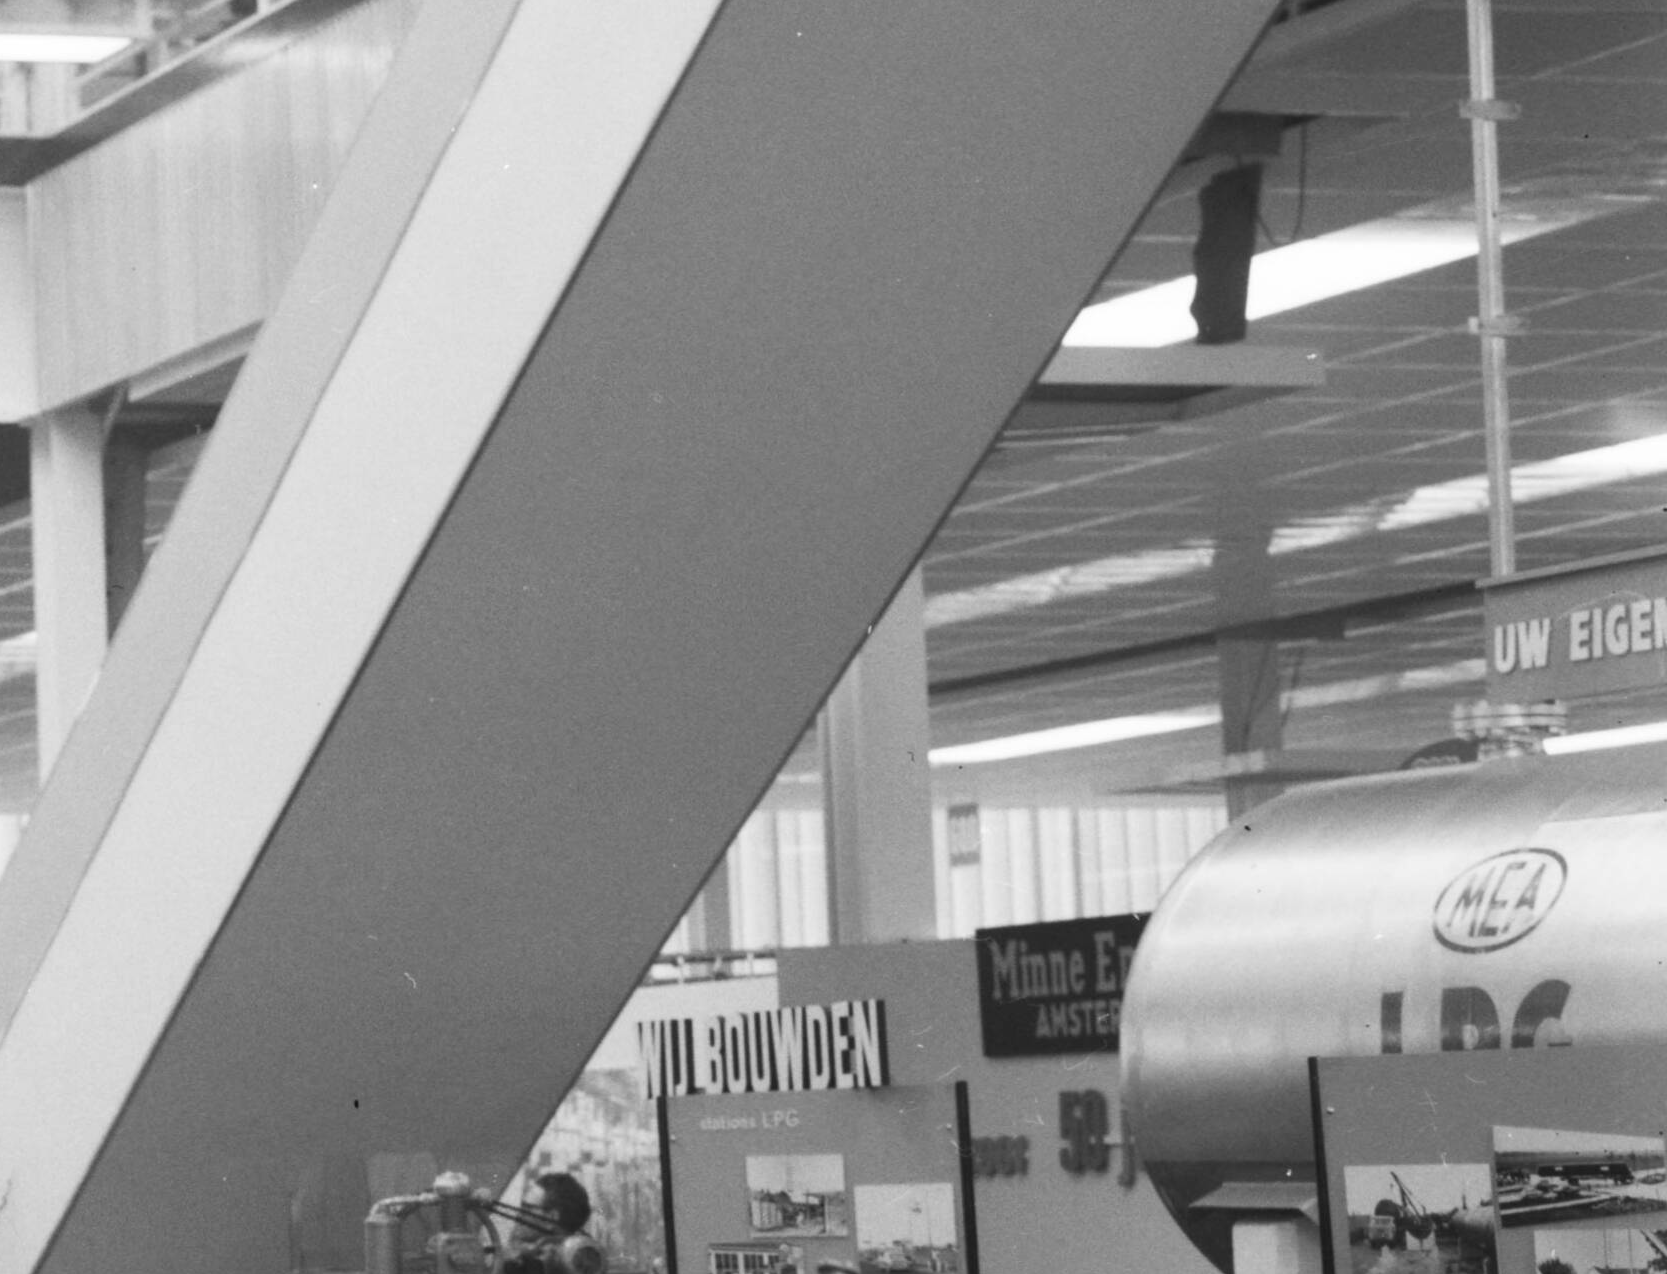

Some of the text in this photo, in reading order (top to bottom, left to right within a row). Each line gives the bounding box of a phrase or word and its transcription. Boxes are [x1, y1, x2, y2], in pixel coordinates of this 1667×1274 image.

[1494, 619, 1550, 673] UW
[1446, 861, 1548, 938] MEA
[989, 937, 1085, 999] Minne
[701, 997, 890, 1095] BOUWDEN
[762, 1108, 800, 1129] LPG
